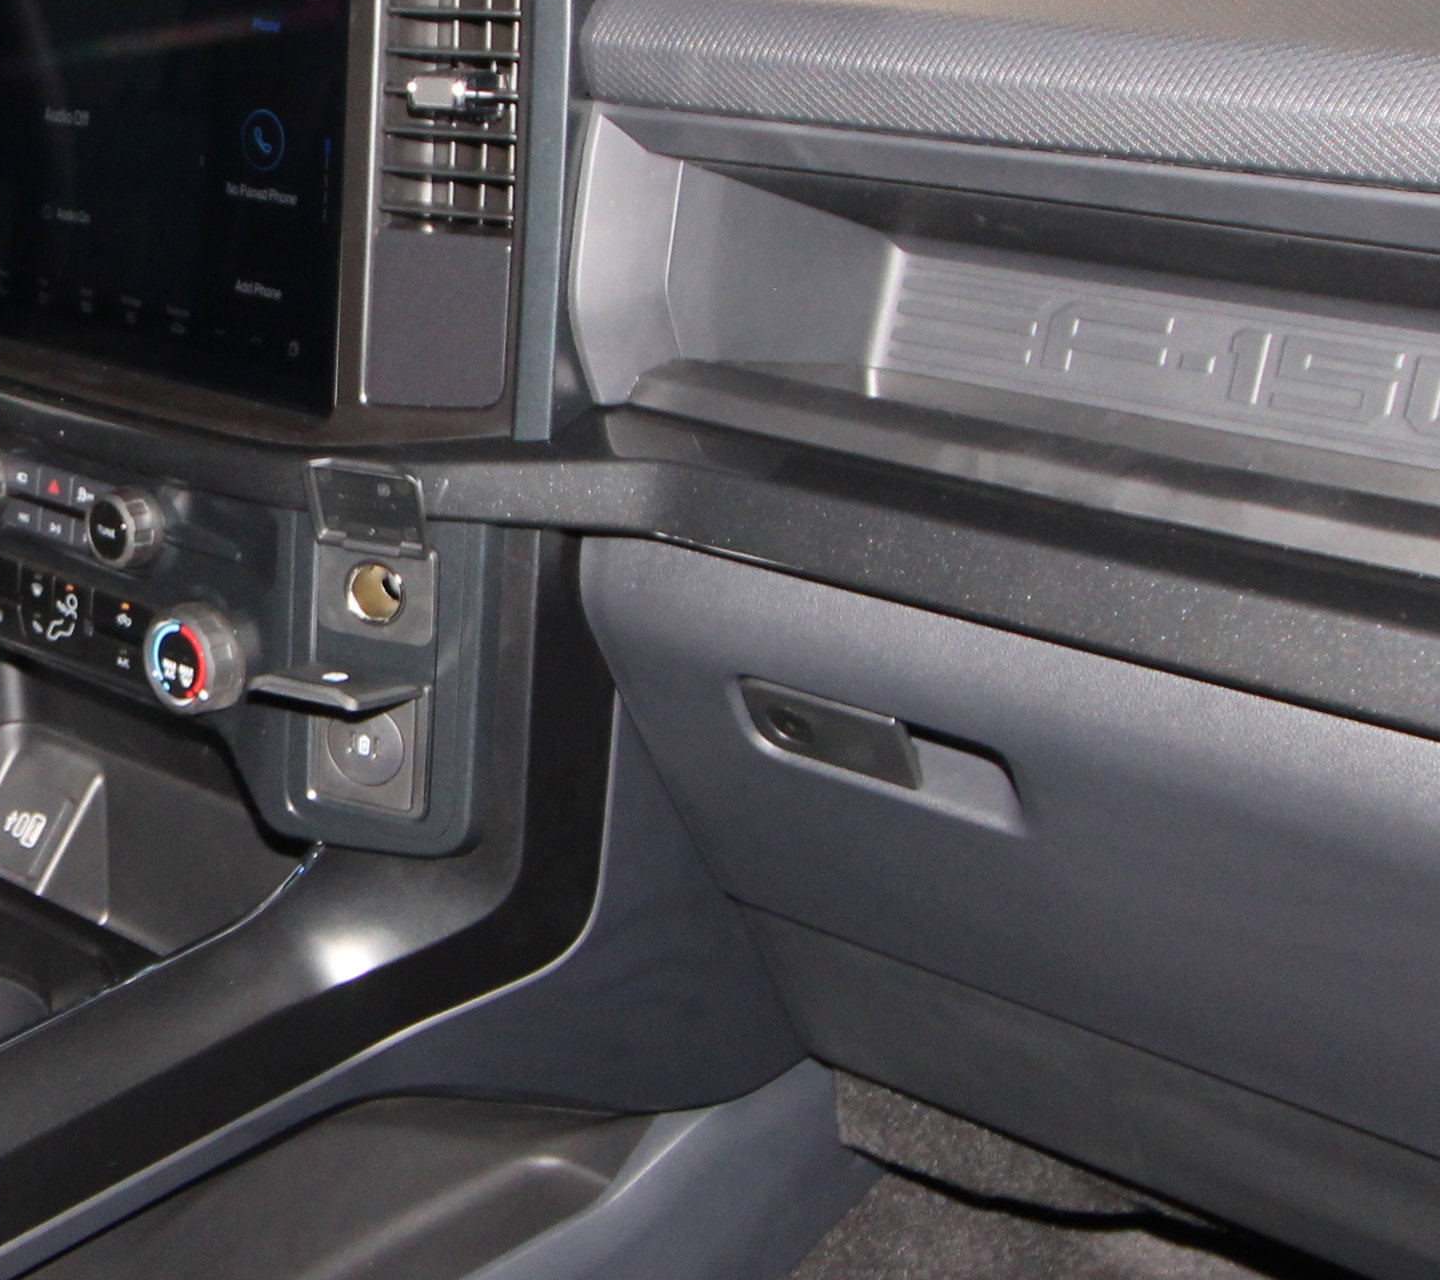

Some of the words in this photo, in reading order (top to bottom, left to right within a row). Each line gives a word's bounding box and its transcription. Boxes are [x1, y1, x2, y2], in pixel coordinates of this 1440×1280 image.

[44, 105, 73, 124] Audio
[74, 109, 90, 127] Off
[226, 181, 239, 197] No
[239, 183, 268, 201] Paired
[268, 187, 298, 207] Phone
[234, 278, 253, 296] Add
[253, 281, 282, 300] Phone
